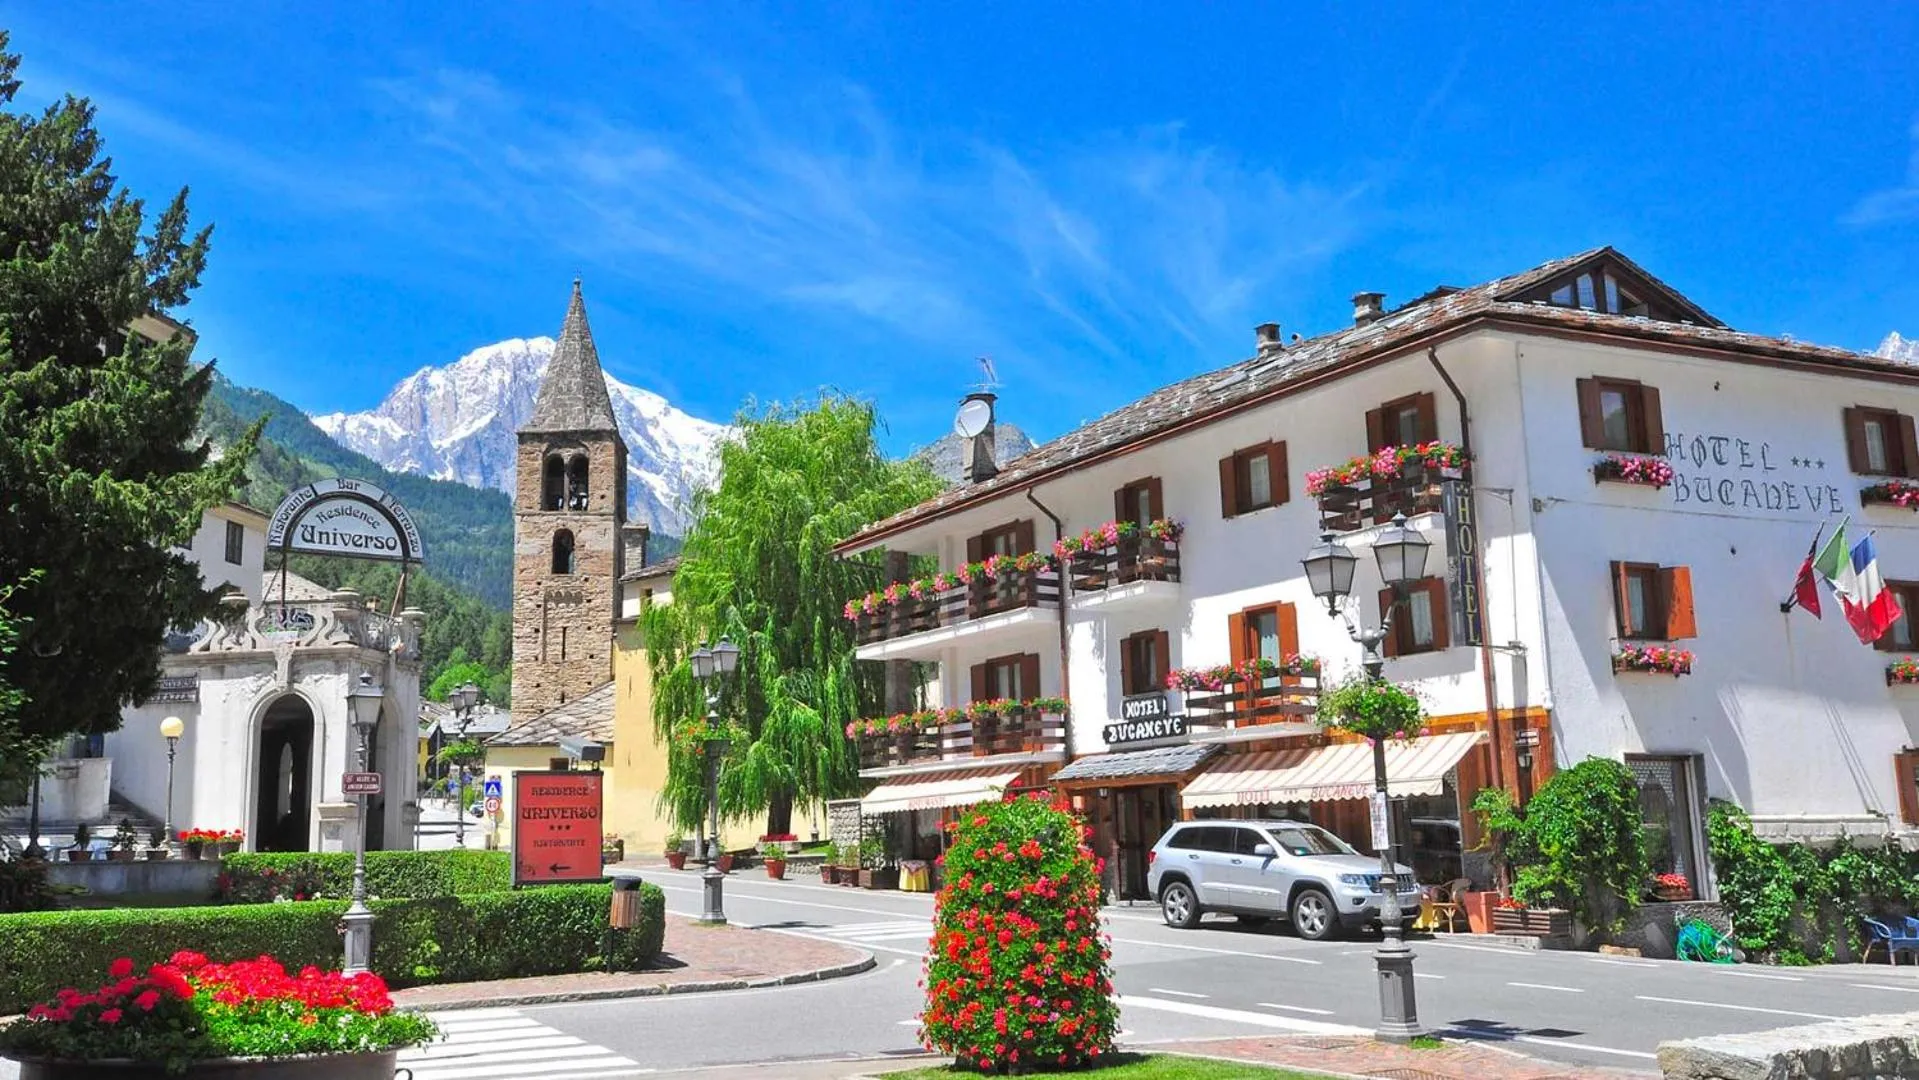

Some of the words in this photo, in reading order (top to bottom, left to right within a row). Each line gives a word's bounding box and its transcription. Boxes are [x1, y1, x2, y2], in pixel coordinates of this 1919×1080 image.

[1664, 433, 1778, 470] HOTEL
[336, 479, 361, 490] Bar
[1674, 473, 1844, 513] BUCANEVE
[269, 488, 313, 545] Ristorante
[315, 504, 382, 530] Residence
[301, 524, 398, 551] Universo
[1456, 496, 1480, 642] HOTEL
[1108, 718, 1182, 742] BUCANEVE
[531, 787, 590, 796] RESIDENCE
[522, 807, 598, 820] UNIVERSO
